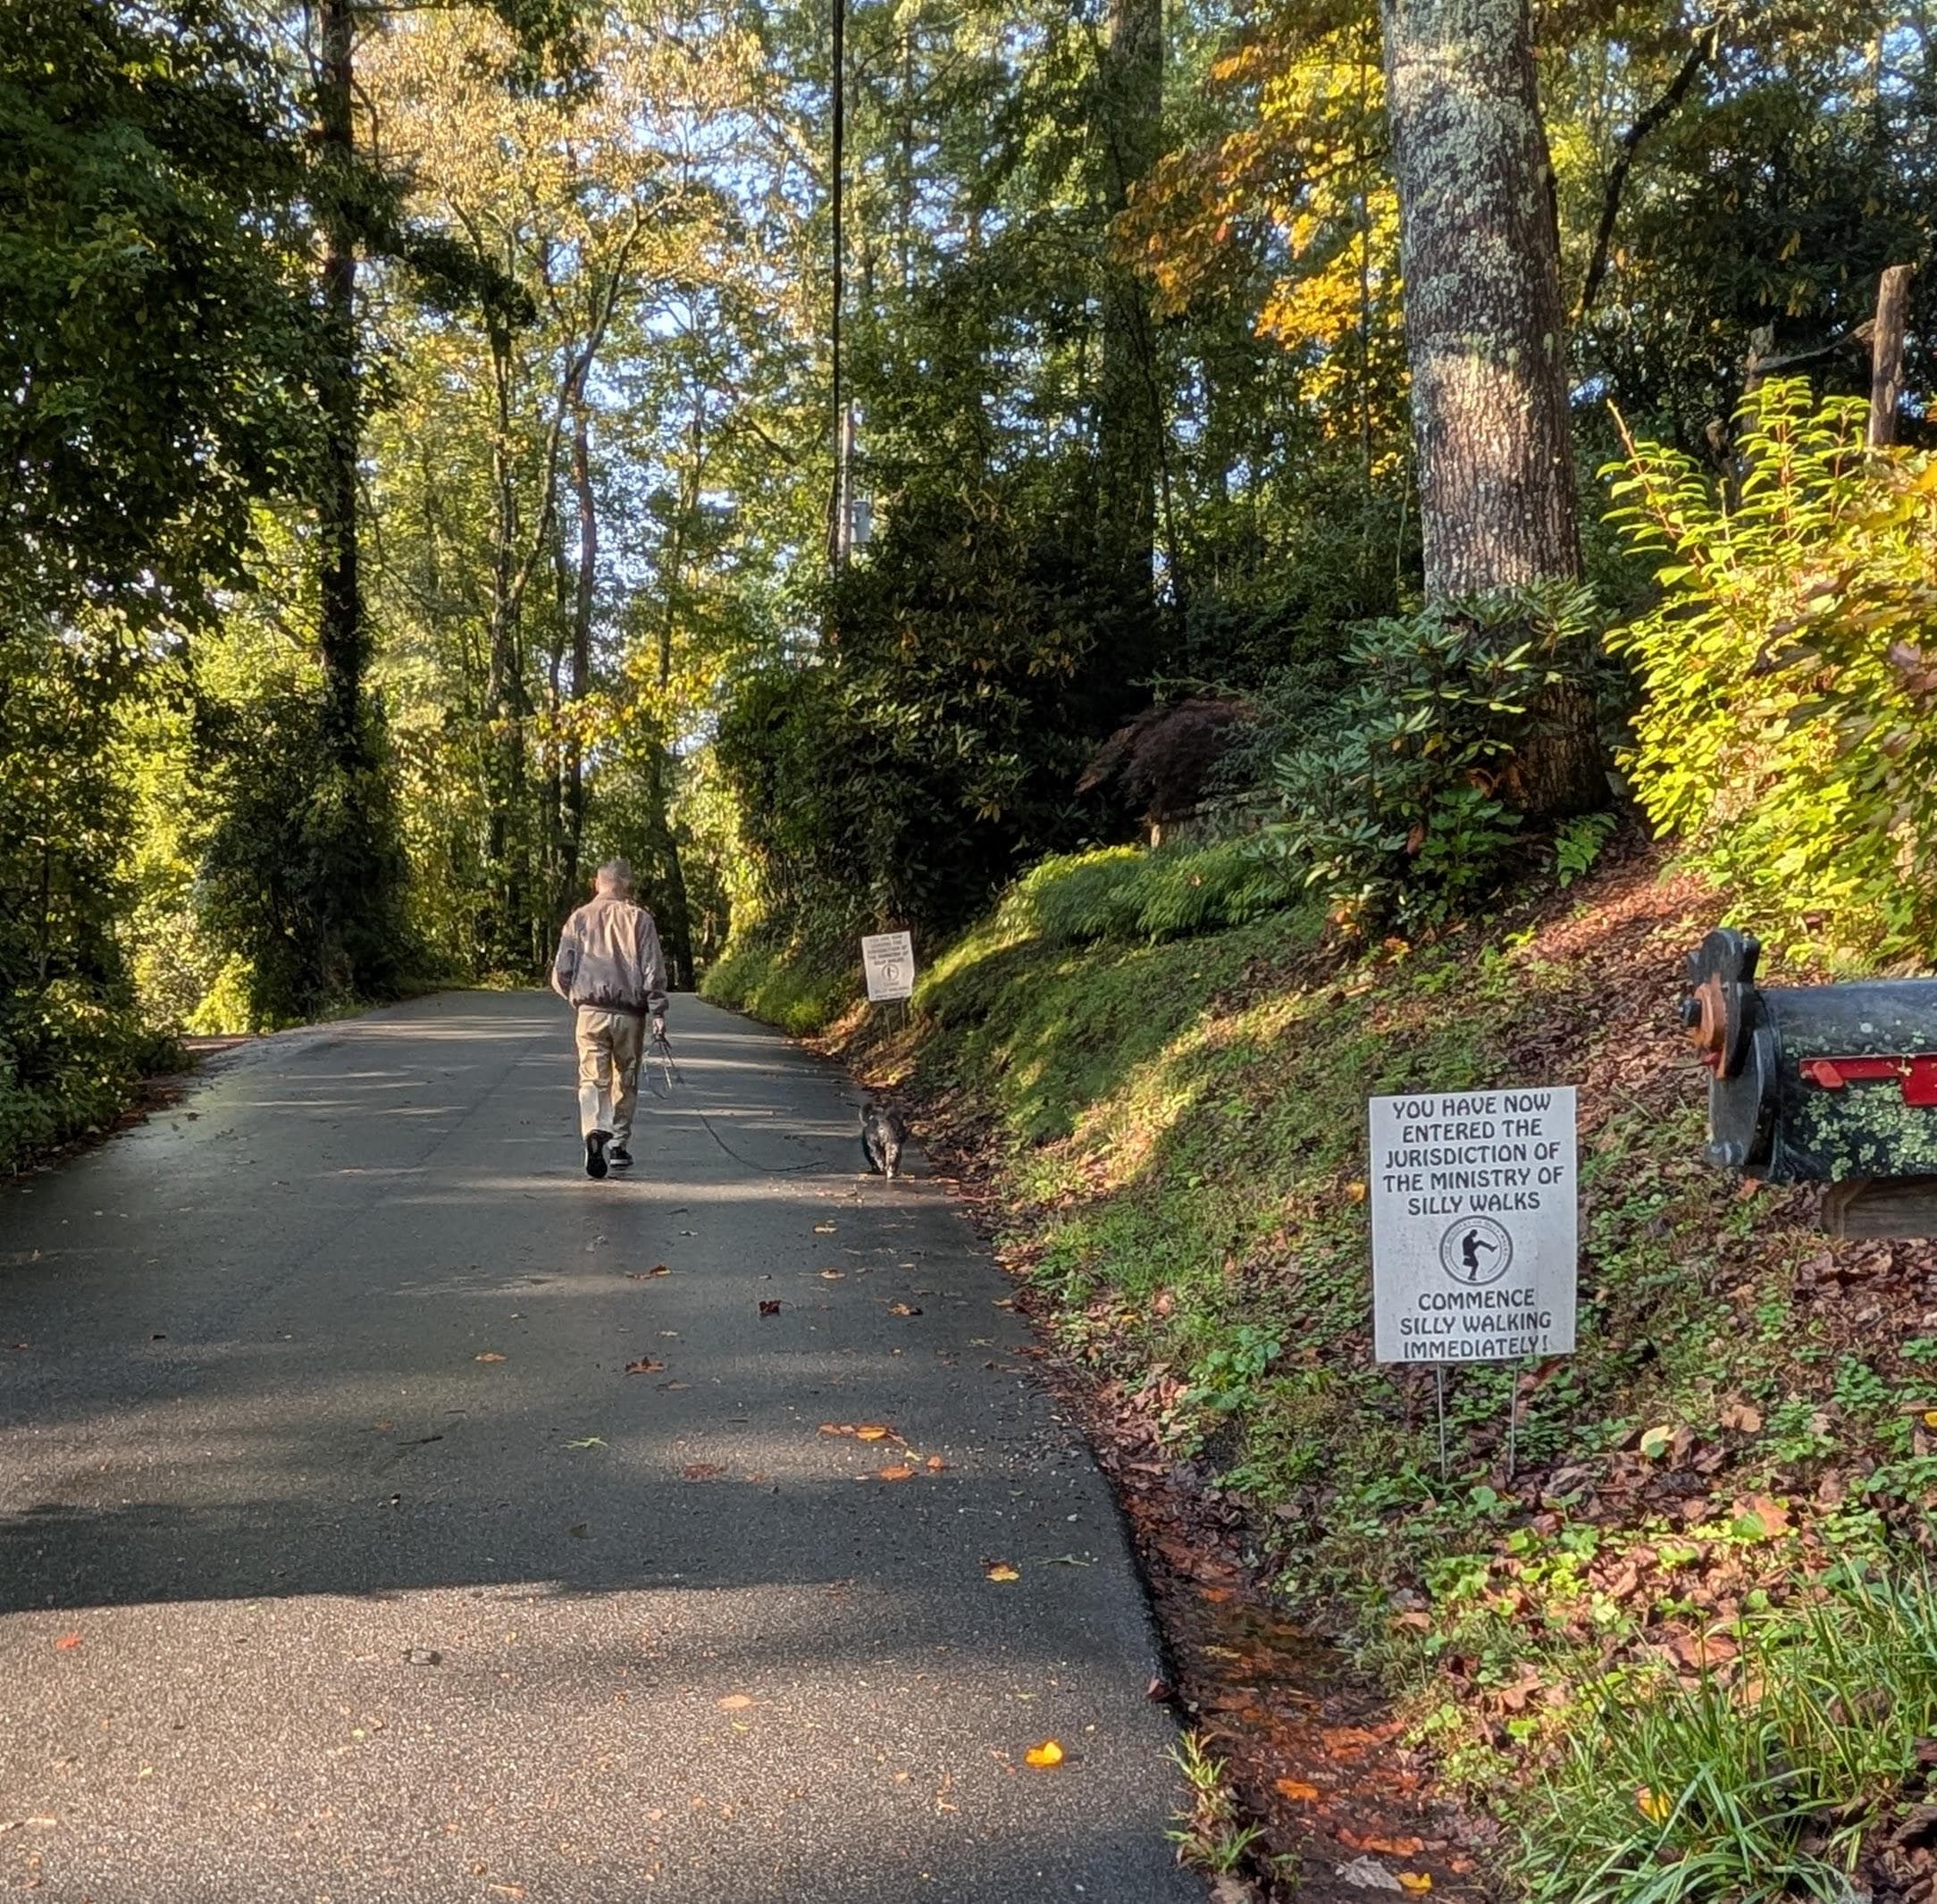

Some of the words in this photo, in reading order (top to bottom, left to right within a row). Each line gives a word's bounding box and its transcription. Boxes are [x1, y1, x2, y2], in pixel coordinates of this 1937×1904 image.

[1393, 1100, 1435, 1119] YOU
[1442, 1097, 1497, 1117] HAVE
[1504, 1093, 1551, 1112] NOW
[1403, 1122, 1495, 1143] ENTERED
[1501, 1119, 1542, 1137] THE
[1386, 1144, 1526, 1169] JURISDICTION
[1534, 1142, 1561, 1160] OF
[1383, 1174, 1422, 1193] THE
[1431, 1168, 1530, 1190] MINISTRY
[1538, 1166, 1564, 1184] OF
[1408, 1195, 1463, 1215] SILLY
[1470, 1192, 1540, 1212] WALKS
[1418, 1288, 1535, 1311] COMMENCE
[1400, 1317, 1456, 1335] SILLY
[1463, 1312, 1551, 1332] WALKING
[1405, 1335, 1547, 1359] IMMEDIATELY!
